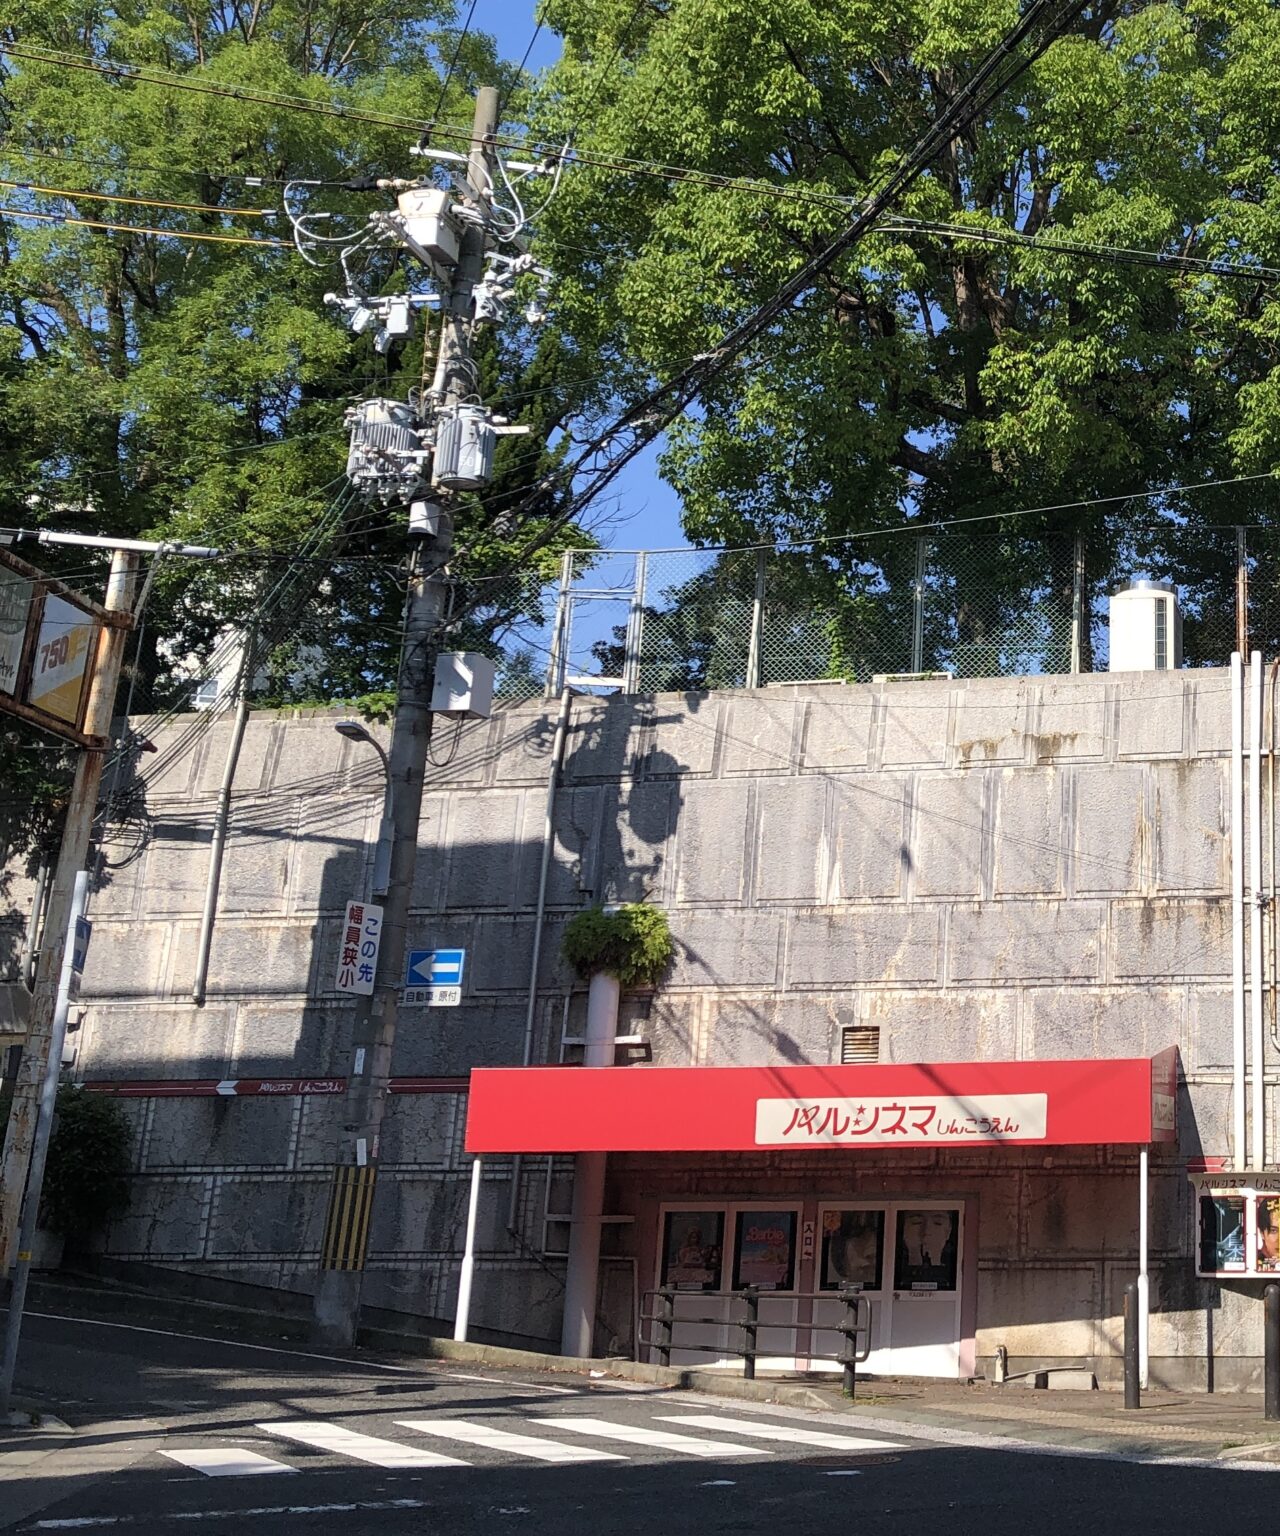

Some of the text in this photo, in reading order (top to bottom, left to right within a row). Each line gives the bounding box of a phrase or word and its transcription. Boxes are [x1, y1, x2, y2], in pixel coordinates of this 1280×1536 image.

[338, 904, 365, 988] 幅員狭小
[357, 917, 378, 983] この先
[782, 1102, 1019, 1137] パルシネマ しんこうえん
[803, 1222, 813, 1247] 入口
